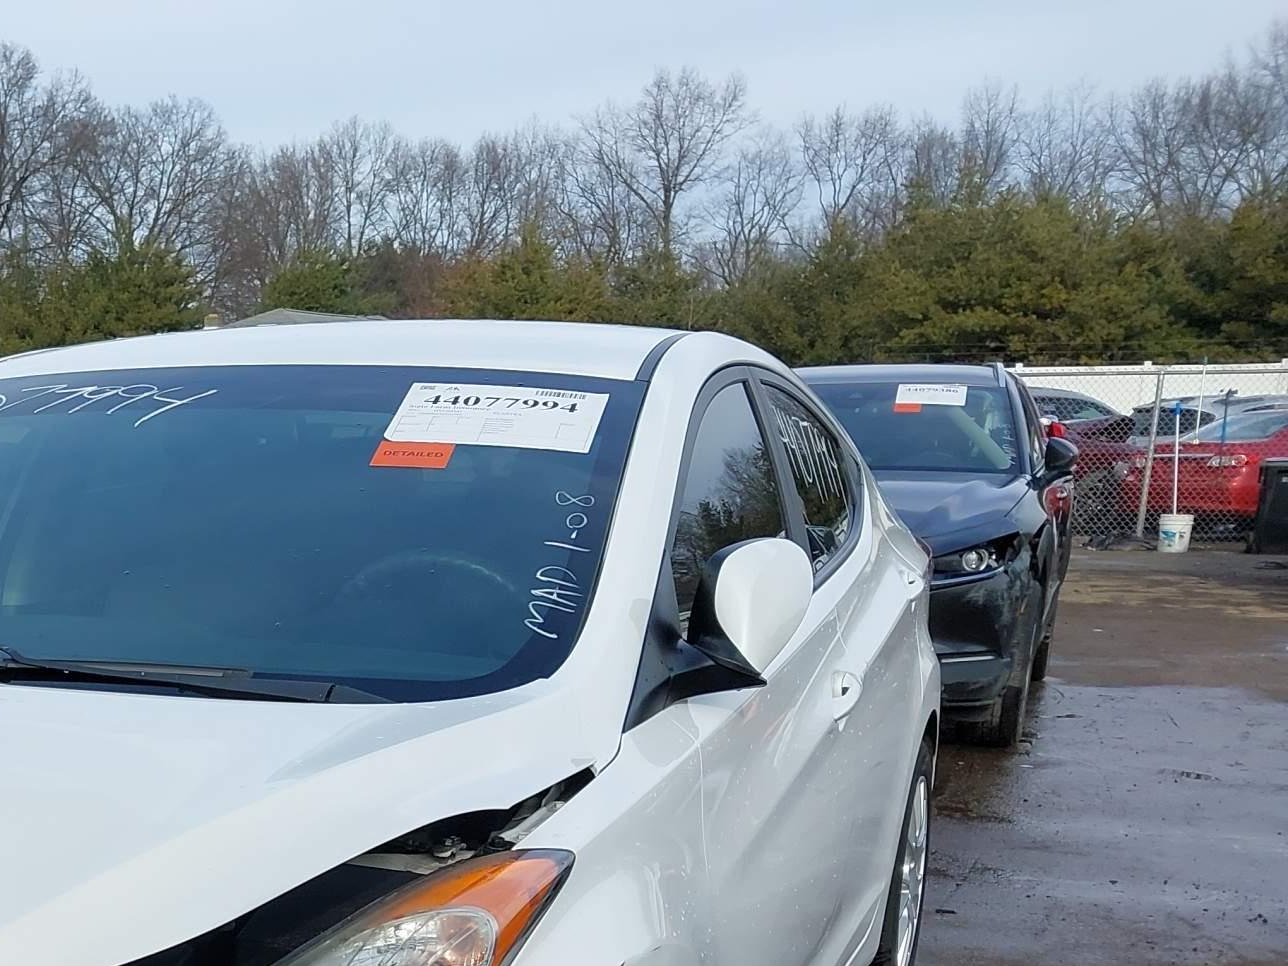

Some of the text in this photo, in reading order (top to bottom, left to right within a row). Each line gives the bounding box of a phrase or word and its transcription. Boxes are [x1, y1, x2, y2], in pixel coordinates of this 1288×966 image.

[423, 393, 579, 413] 44077994
[383, 449, 444, 458] DETAILED
[524, 490, 595, 639] MAD 1-08
